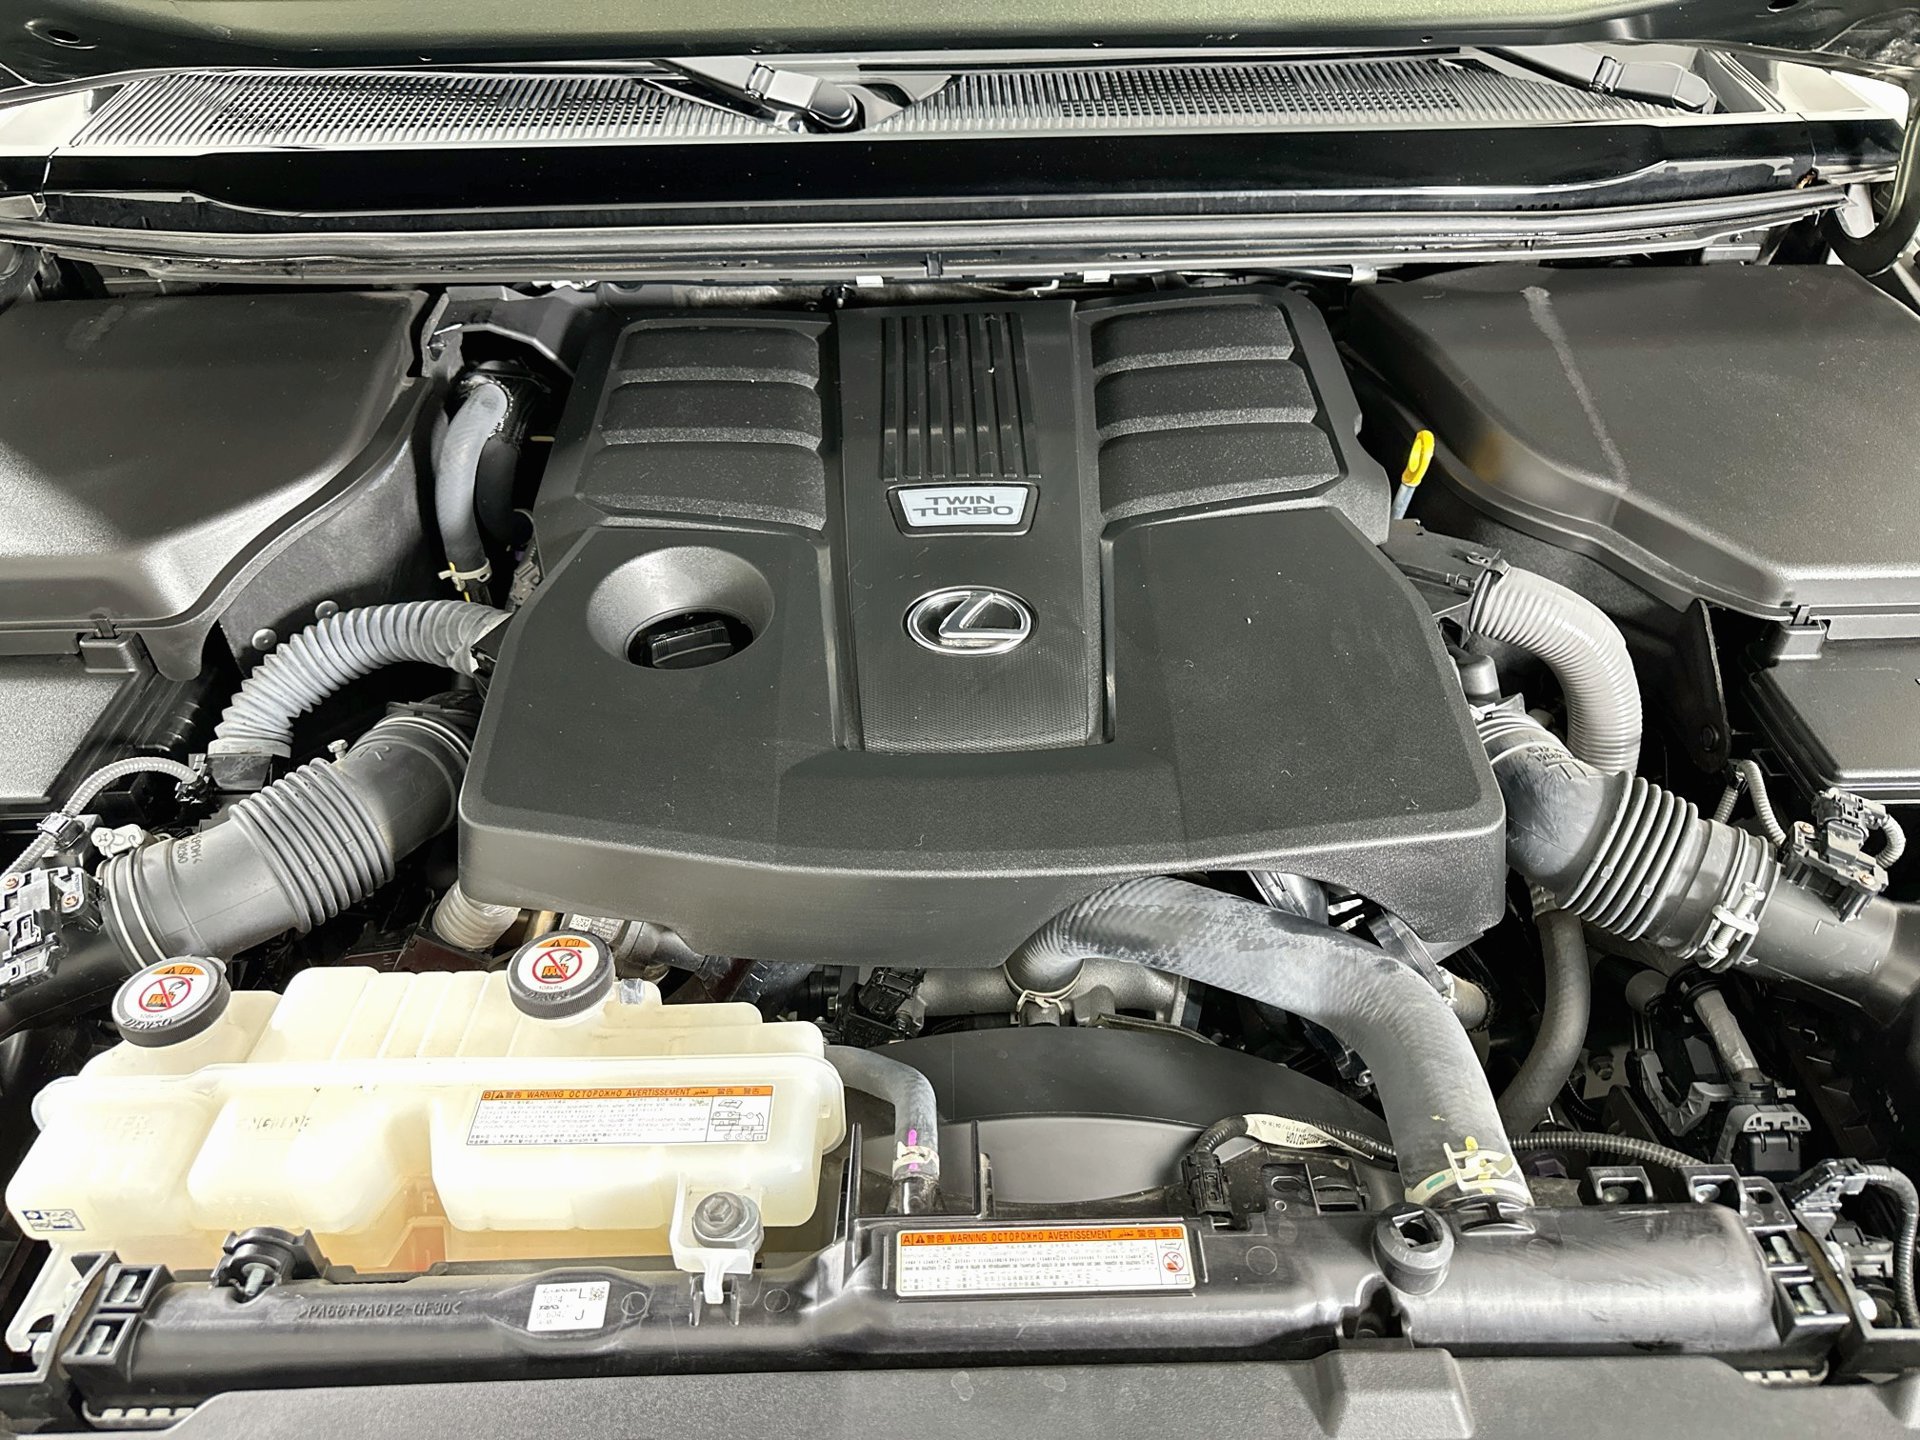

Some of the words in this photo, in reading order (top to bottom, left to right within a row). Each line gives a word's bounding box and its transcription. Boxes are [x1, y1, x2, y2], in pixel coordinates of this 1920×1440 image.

[925, 495, 995, 505] TWIN
[912, 506, 1014, 517] TURBO
[123, 1018, 173, 1030] DENSO
[527, 1089, 564, 1098] WARNING
[626, 1088, 690, 1097] AVERTISSEMENT
[950, 1232, 988, 1242] WARNING
[1048, 1229, 1112, 1240] AVERTISSEMENT
